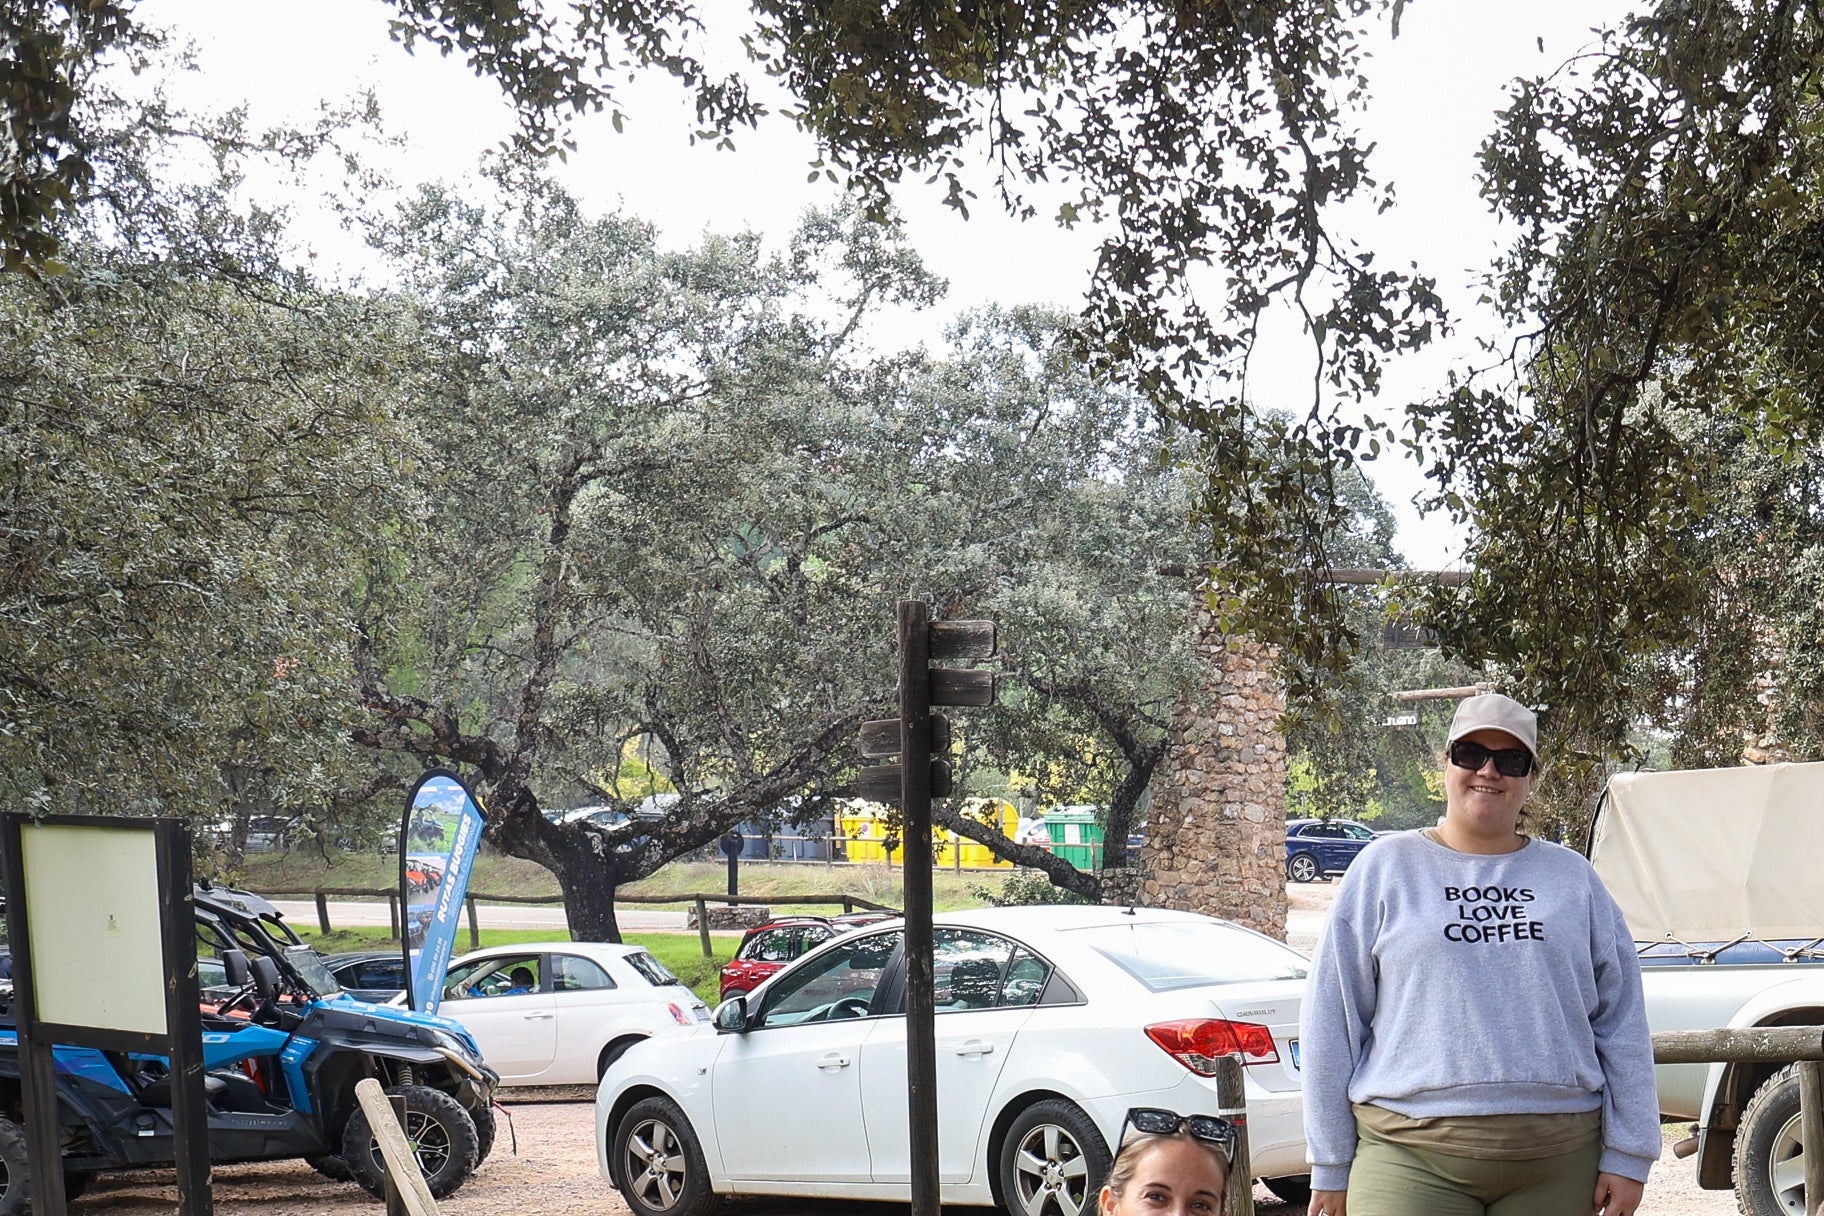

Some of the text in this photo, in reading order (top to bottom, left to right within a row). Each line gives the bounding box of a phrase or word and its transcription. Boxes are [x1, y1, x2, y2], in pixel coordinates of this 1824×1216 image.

[437, 873, 456, 924] RUTAS
[449, 813, 472, 876] BUGGIES
[1444, 885, 1536, 902] BOOKS
[1459, 904, 1527, 922] LOVE
[1443, 920, 1545, 943] COFFEE
